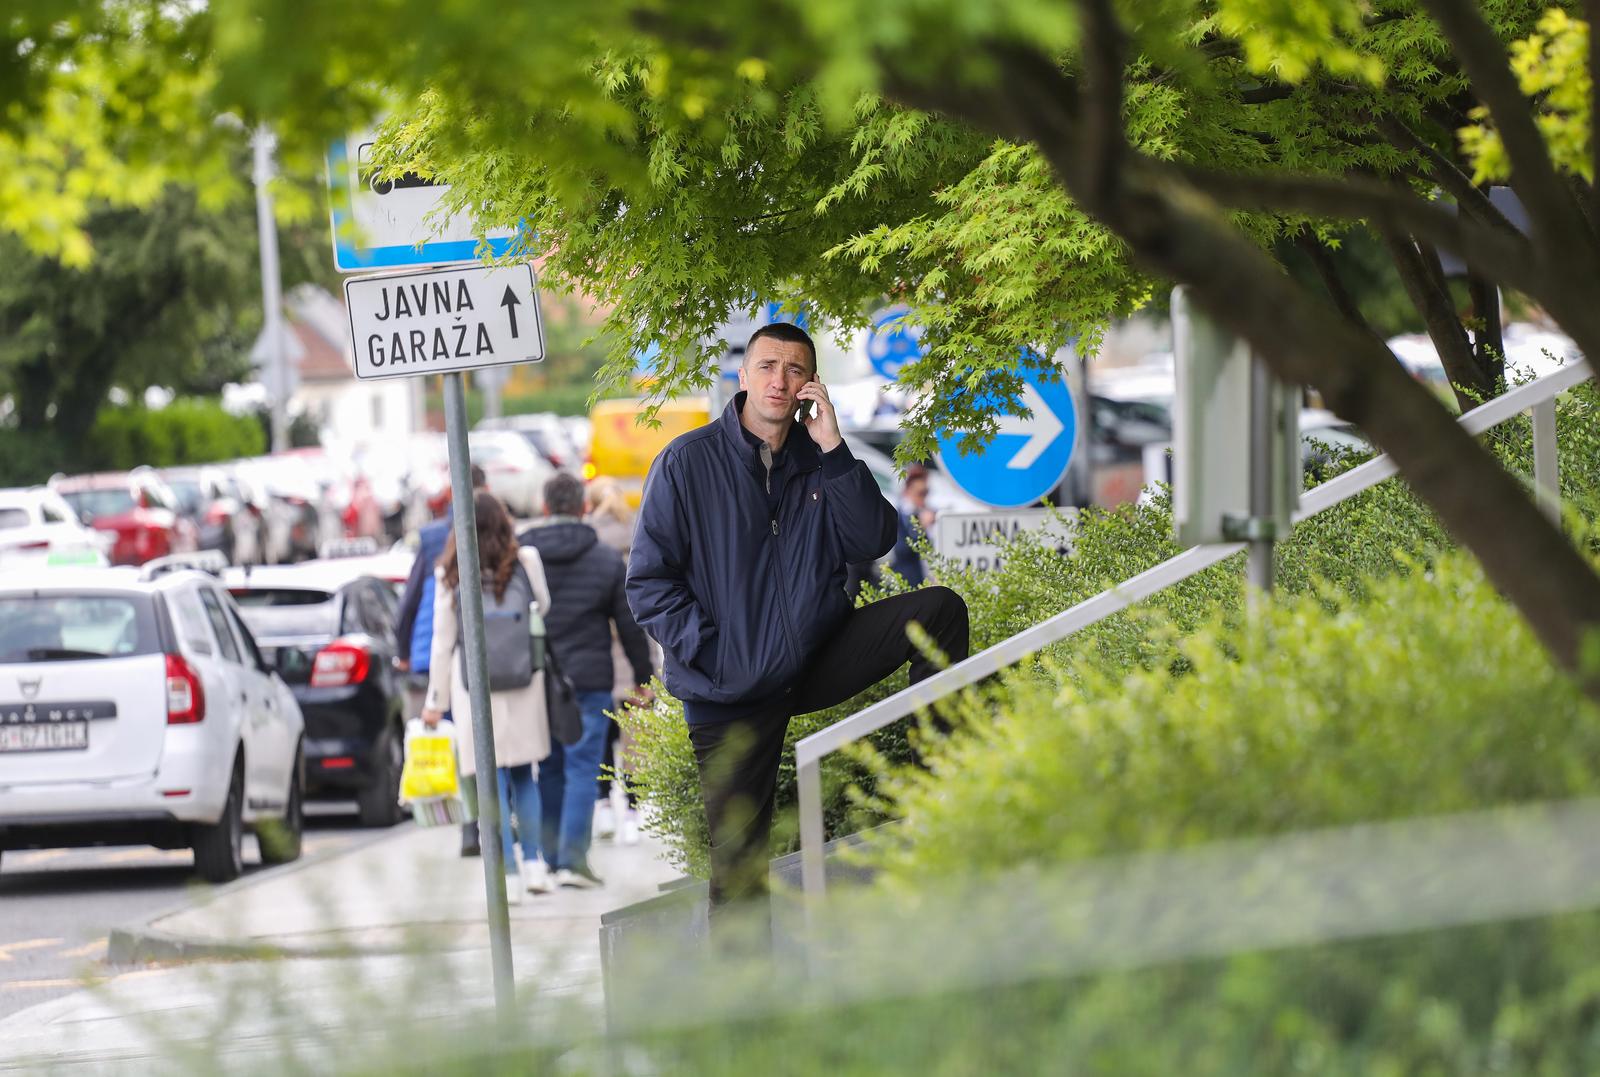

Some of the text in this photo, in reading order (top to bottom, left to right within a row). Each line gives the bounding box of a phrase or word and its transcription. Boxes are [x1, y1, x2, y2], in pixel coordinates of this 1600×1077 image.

[374, 278, 475, 321] JAVNA
[367, 316, 495, 367] GARAŽA
[954, 519, 1021, 547] JAVNA
